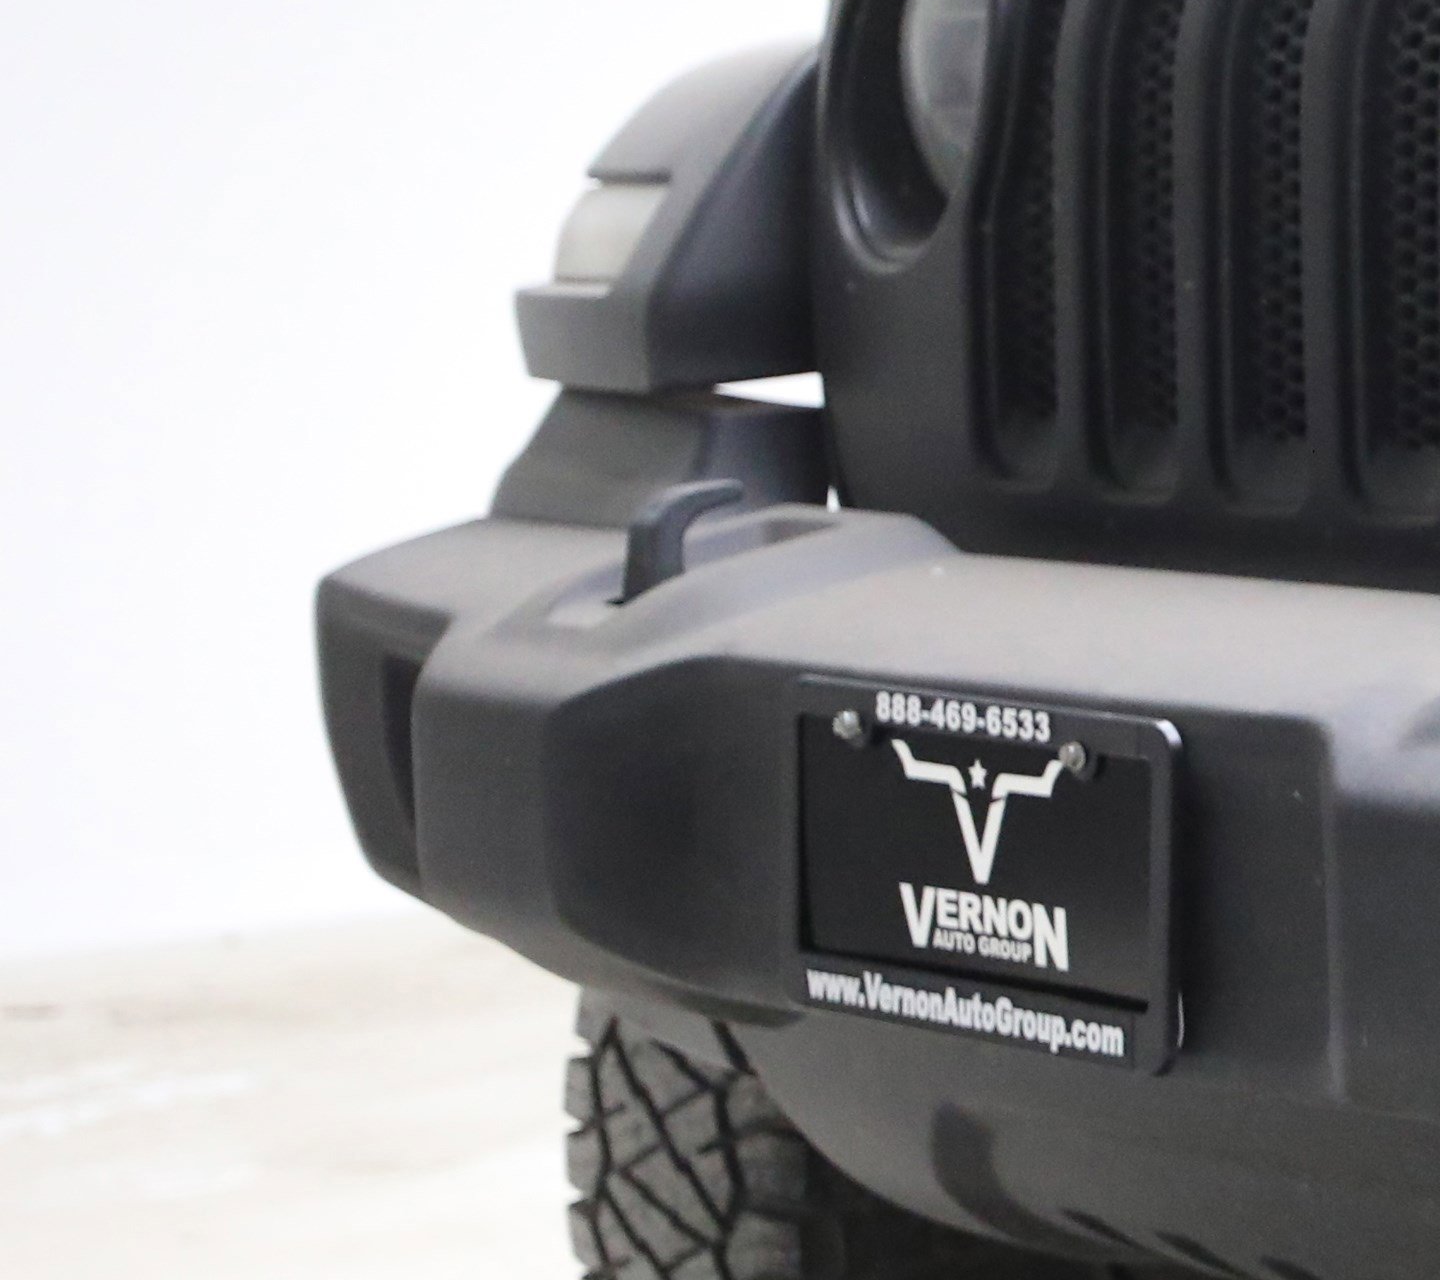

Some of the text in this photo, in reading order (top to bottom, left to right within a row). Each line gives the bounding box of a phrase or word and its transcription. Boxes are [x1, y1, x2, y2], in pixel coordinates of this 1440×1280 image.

[876, 691, 1051, 743] 888-469-6533
[899, 881, 1069, 972] VERNON
[933, 931, 1033, 963] AUTO GROUP
[807, 968, 1124, 1056] www.VernonAutoGroup.com
